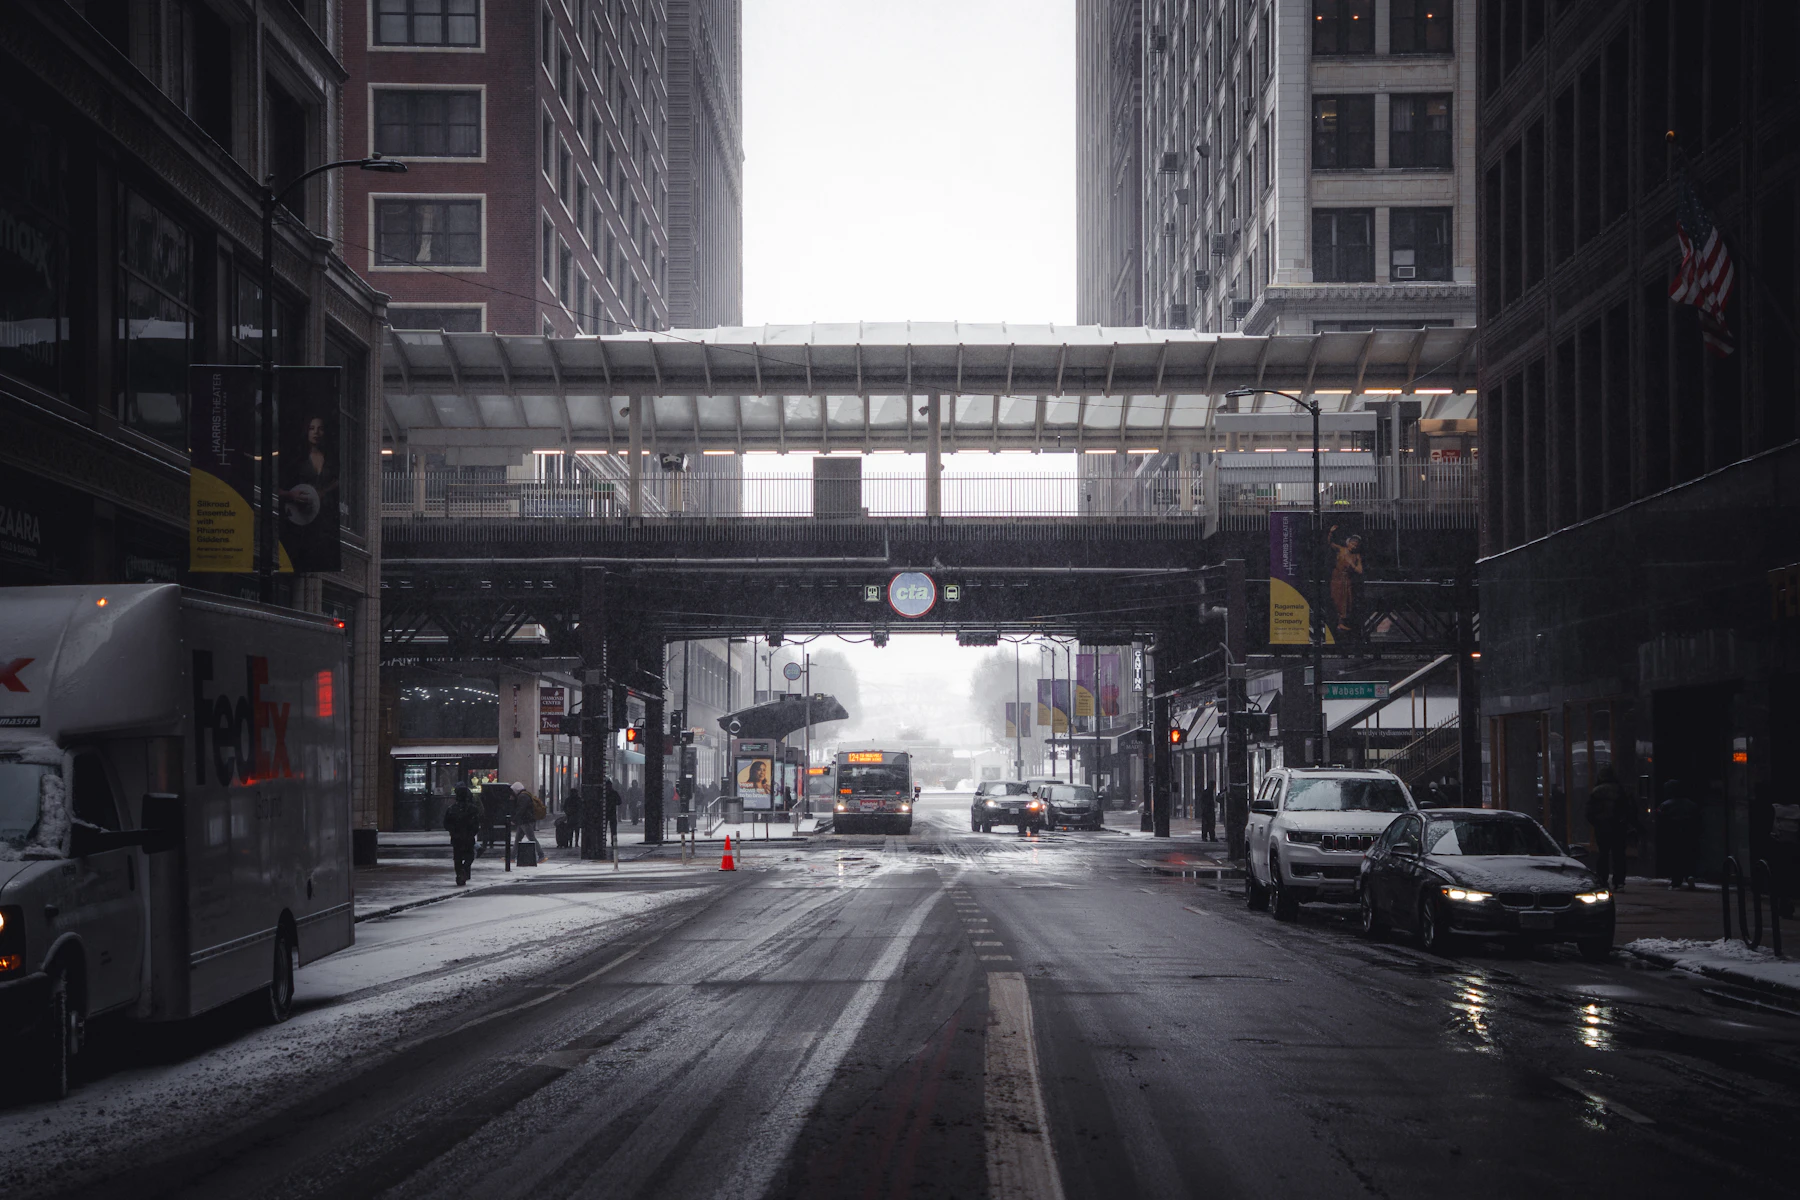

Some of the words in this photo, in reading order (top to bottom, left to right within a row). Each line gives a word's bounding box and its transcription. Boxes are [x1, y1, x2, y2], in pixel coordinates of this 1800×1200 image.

[212, 373, 221, 414] THEATER
[212, 416, 221, 453] HARRIS
[197, 500, 230, 508] Silkroad
[896, 584, 928, 600] cta
[1332, 686, 1364, 695] Wabash
[193, 650, 292, 787] FedEx
[849, 753, 859, 761] 124
